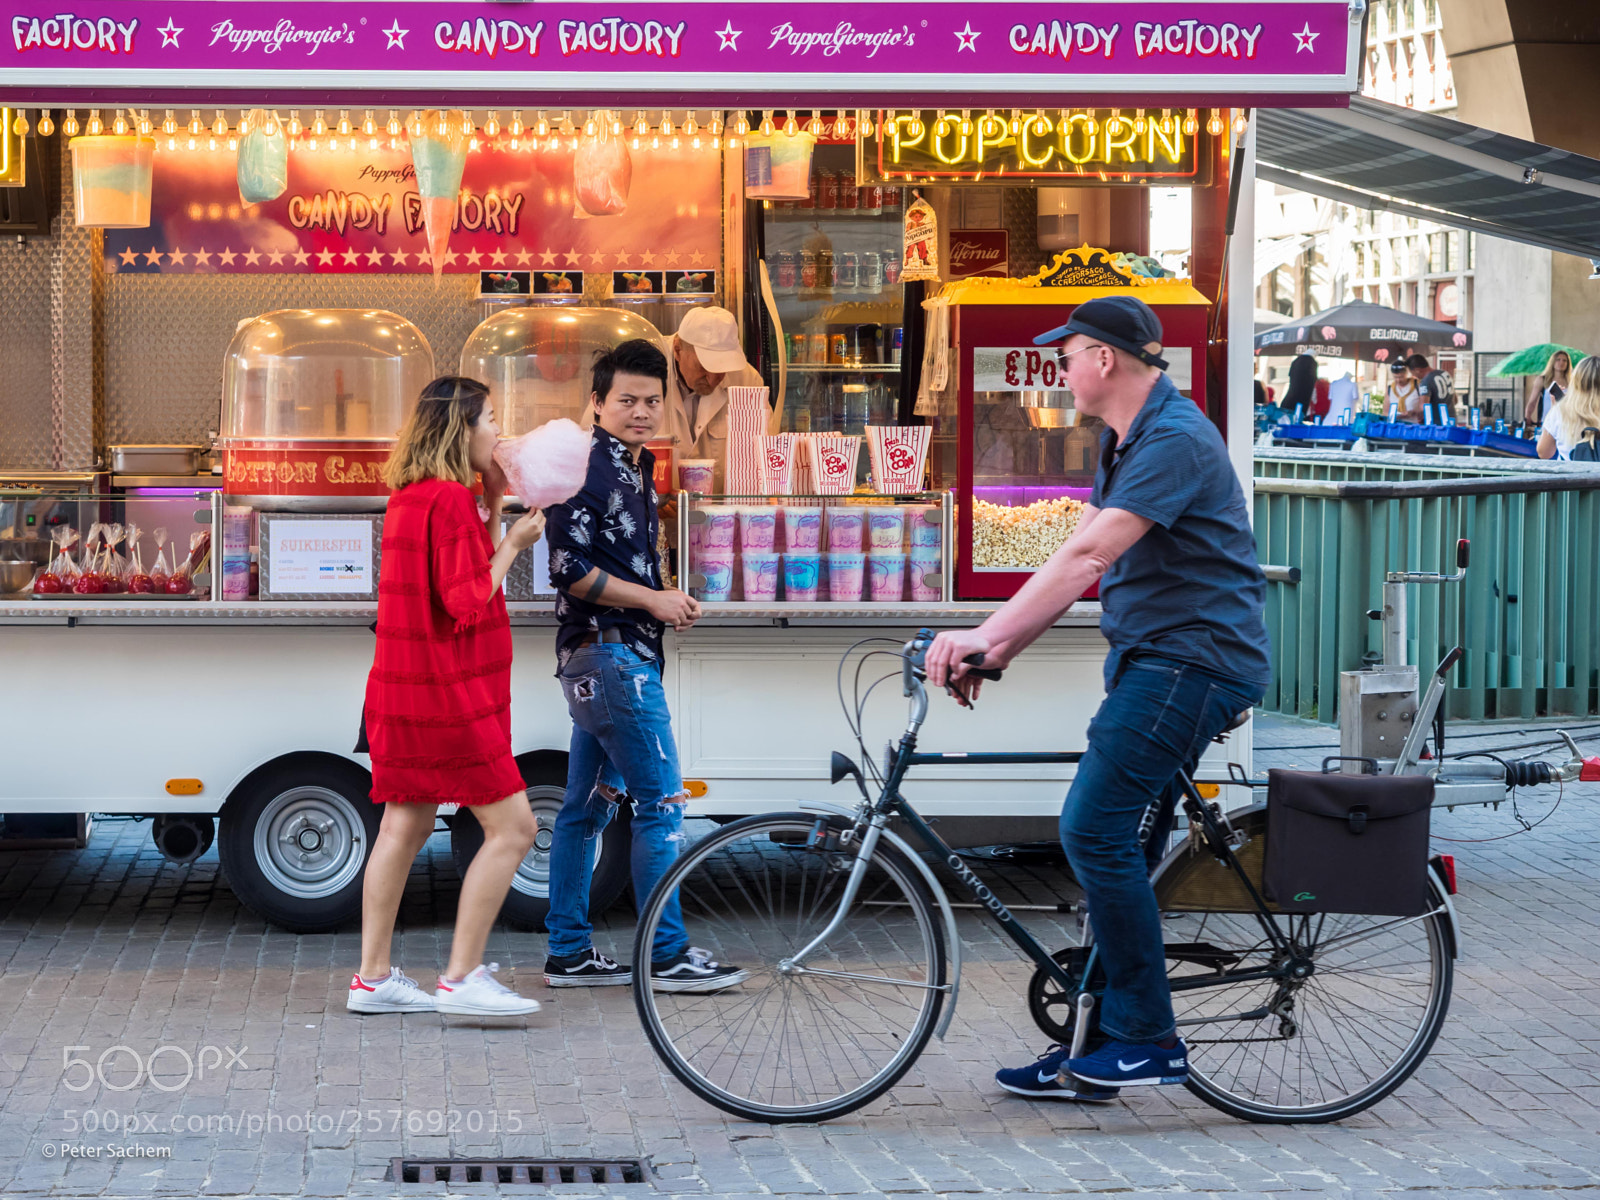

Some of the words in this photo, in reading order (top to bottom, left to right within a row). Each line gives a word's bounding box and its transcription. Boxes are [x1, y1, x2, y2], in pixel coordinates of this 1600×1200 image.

[12, 14, 139, 53] FACTORY
[209, 18, 355, 56] PappaGiorgio's
[434, 18, 545, 58] CANDY
[558, 17, 687, 57] FACTORY
[767, 21, 915, 58] PappaGiorgio's
[1009, 20, 1121, 60] CANDY
[1134, 19, 1264, 60] FACTORY
[893, 113, 1181, 165] POPCORN
[288, 189, 394, 236] CANDY
[1370, 328, 1418, 341] DELIRIUM
[769, 454, 781, 462] POP
[771, 459, 785, 468] CORN
[825, 455, 842, 467] POP
[889, 448, 908, 461] POP
[891, 455, 914, 470] CORN
[827, 462, 847, 475] CORN
